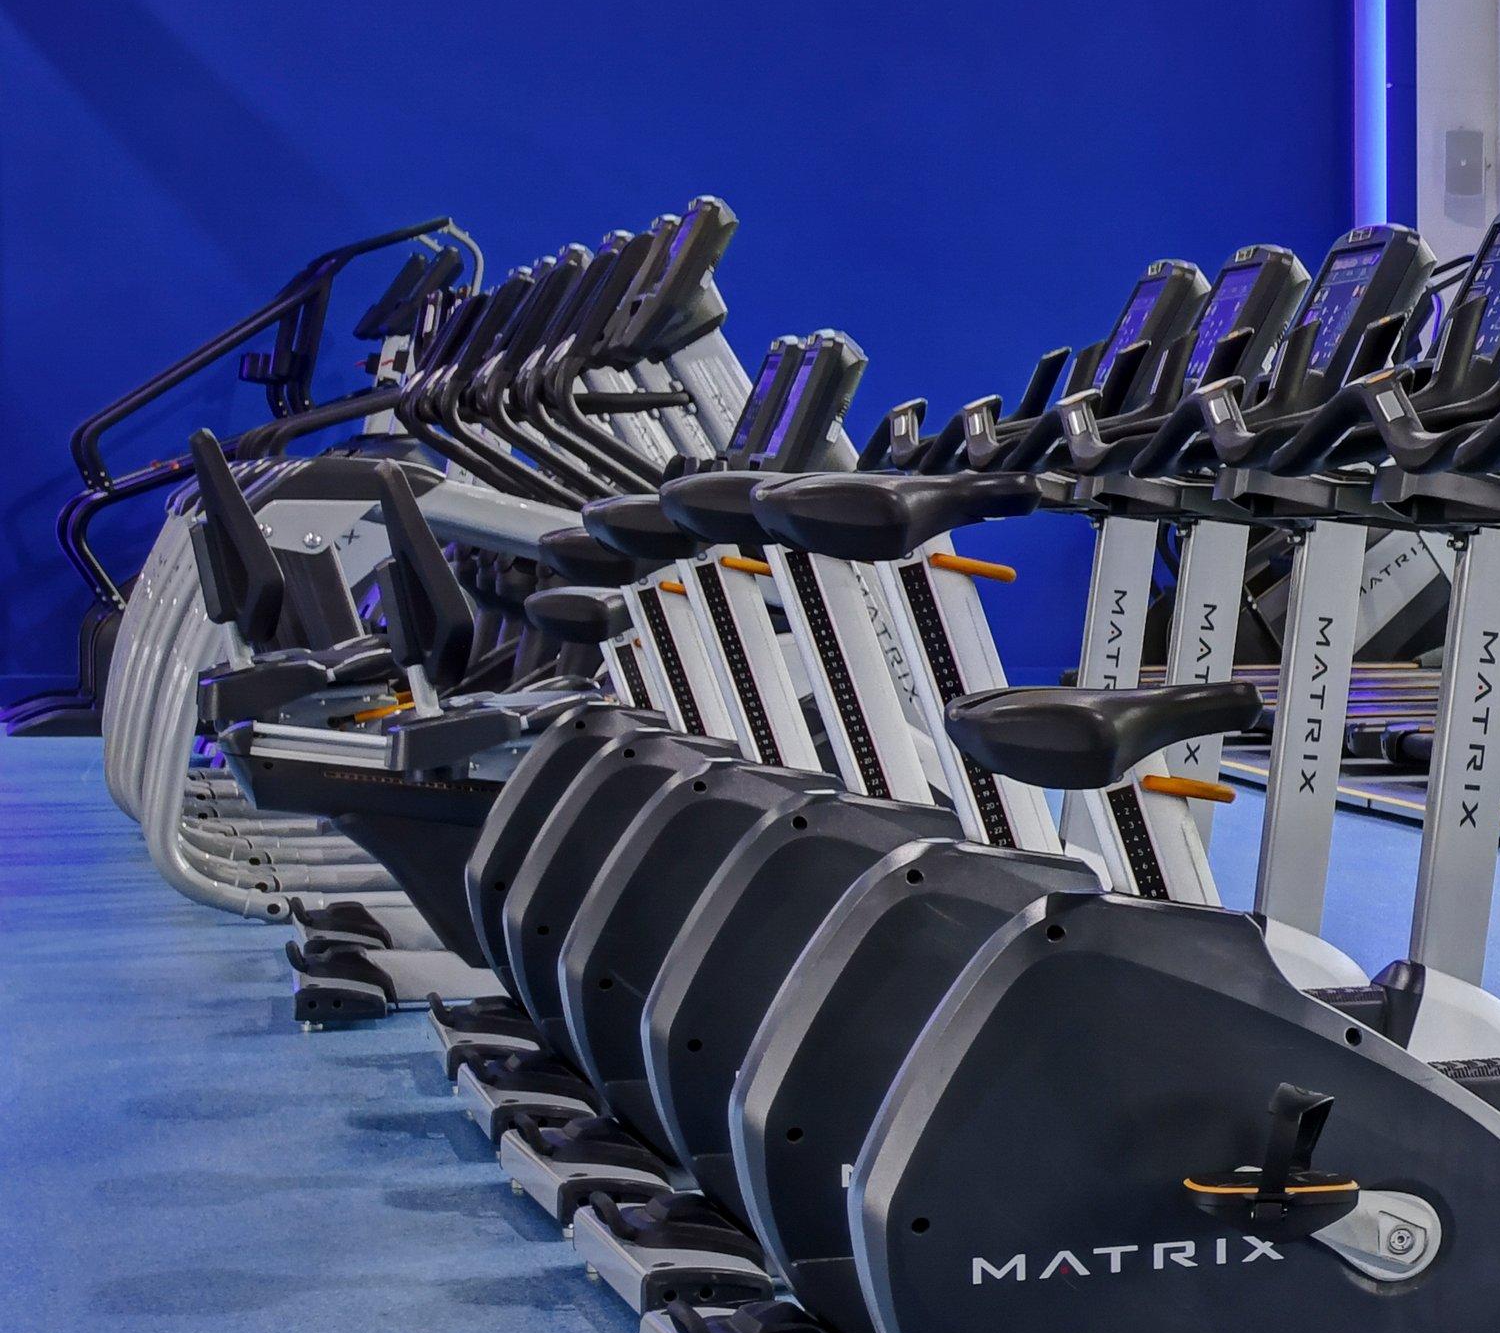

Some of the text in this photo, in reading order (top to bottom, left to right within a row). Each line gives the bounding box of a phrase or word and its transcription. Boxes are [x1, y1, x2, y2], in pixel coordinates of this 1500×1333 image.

[1299, 617, 1334, 795] MATRIX
[1459, 631, 1499, 829] MATRIX
[972, 1232, 1285, 1285] MATRIX
